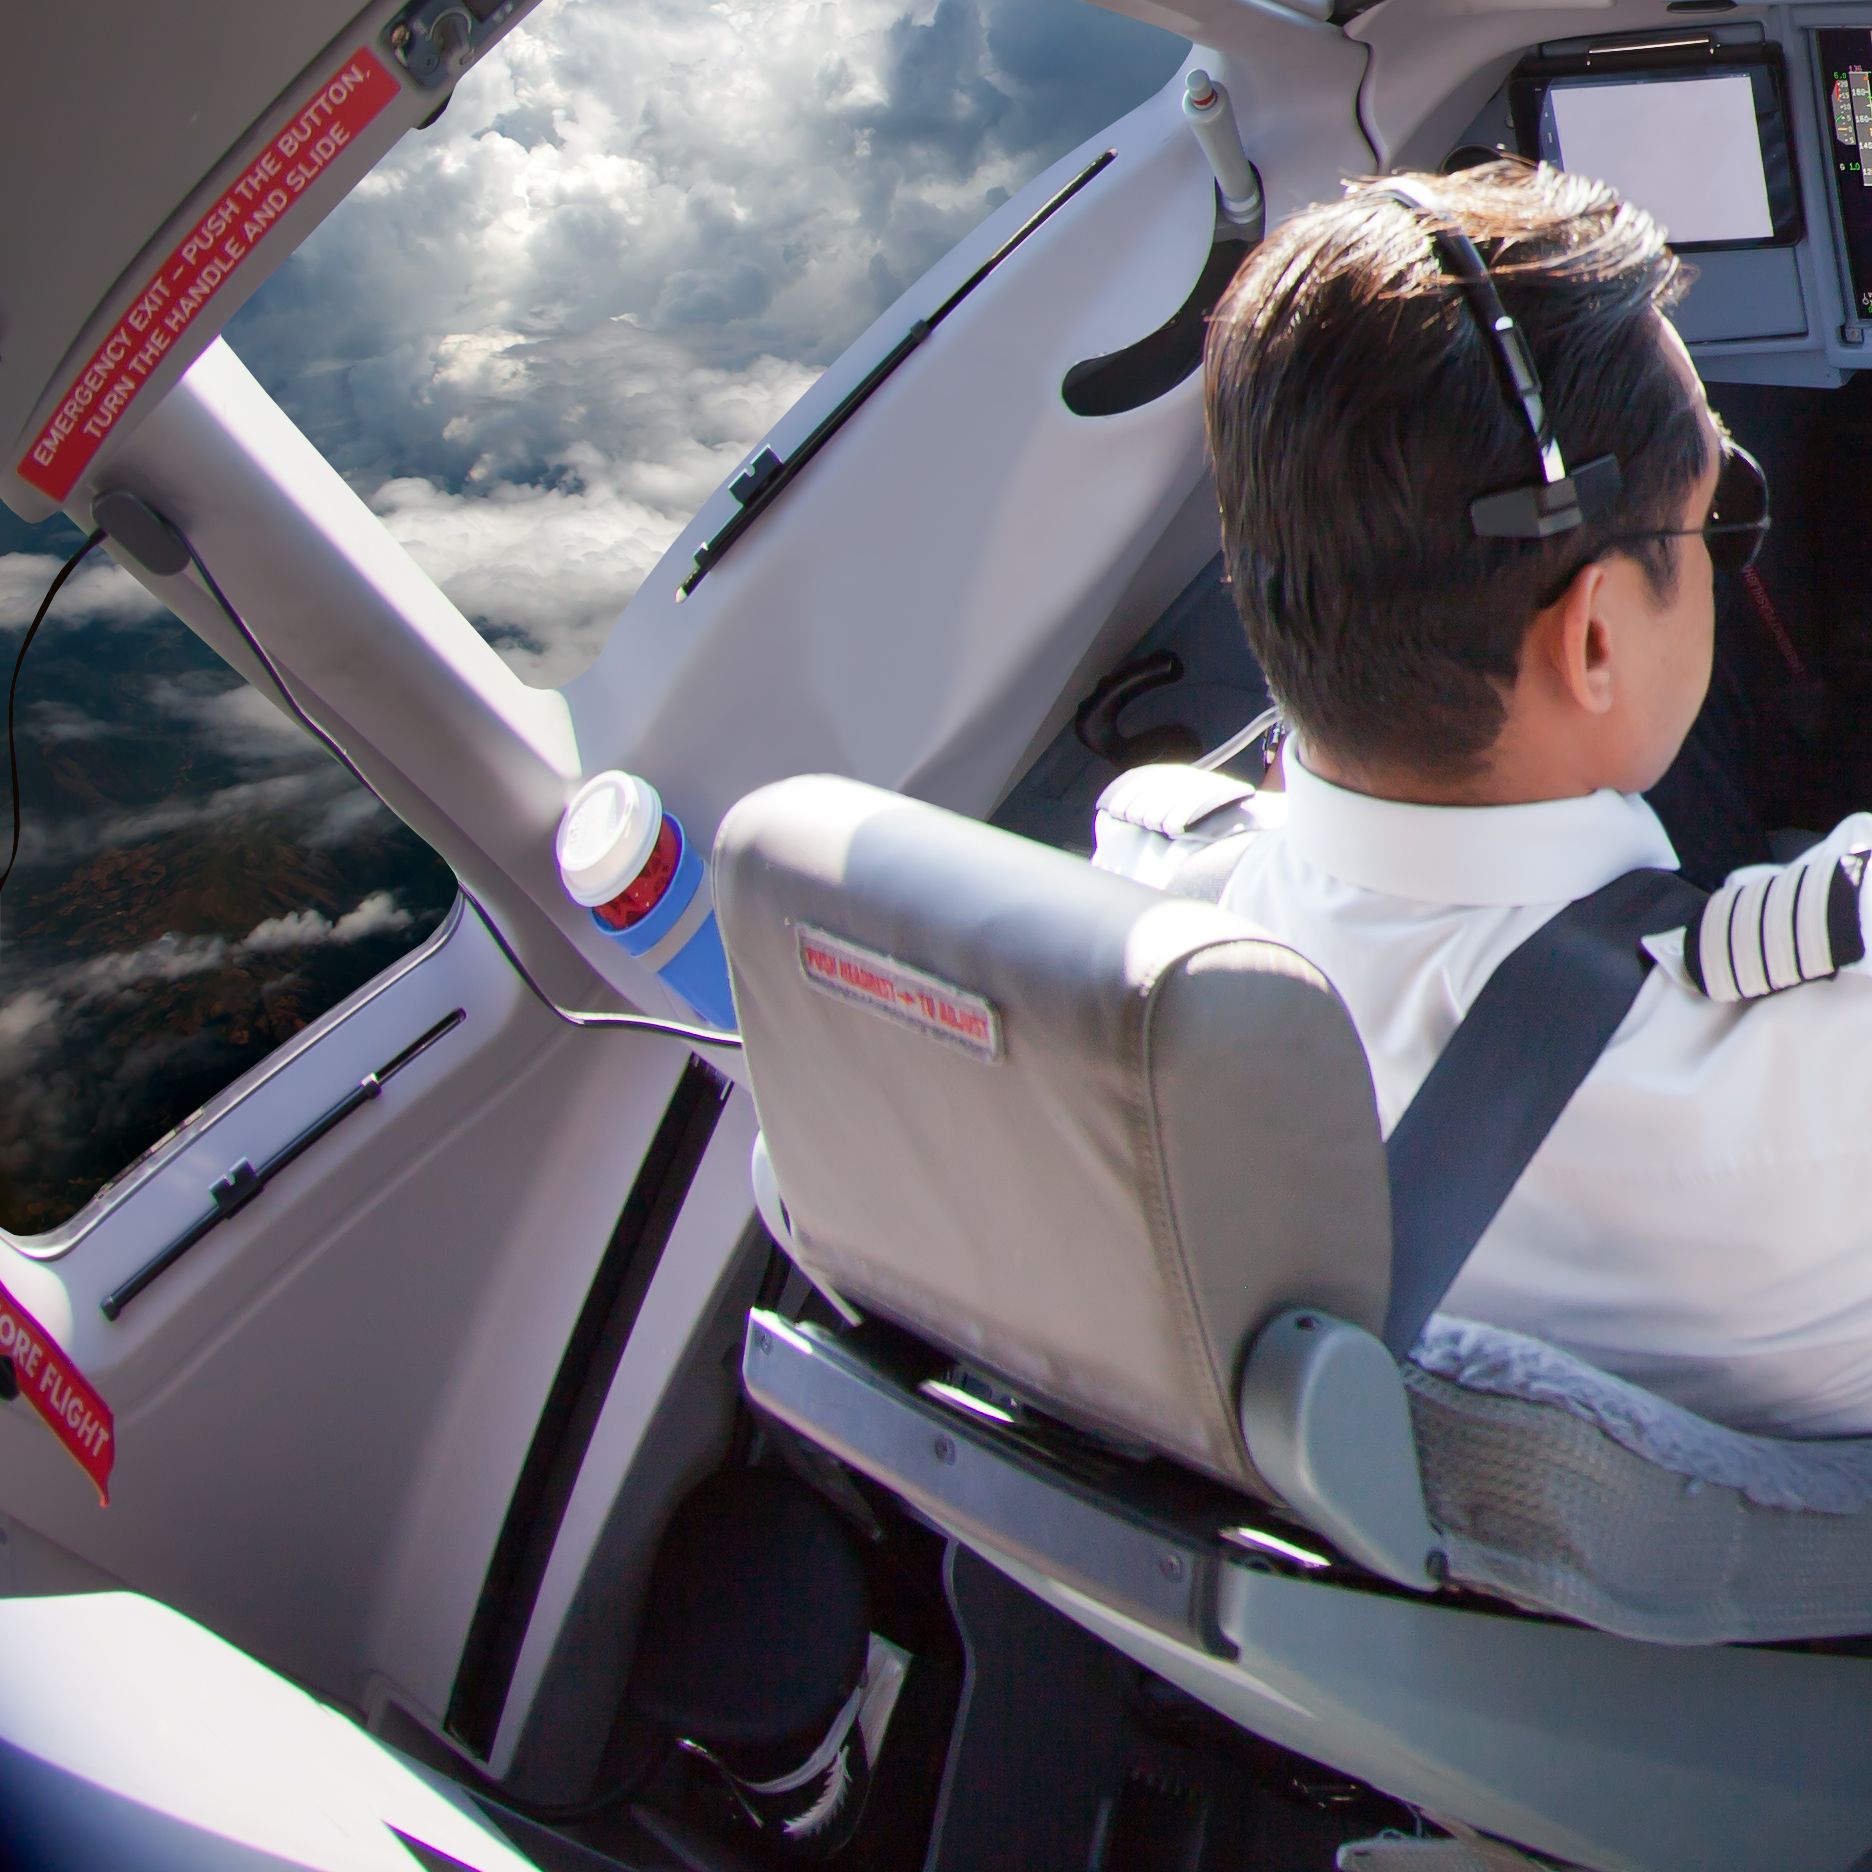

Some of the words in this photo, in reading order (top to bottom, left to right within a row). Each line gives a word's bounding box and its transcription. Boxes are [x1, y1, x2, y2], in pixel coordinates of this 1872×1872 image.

[33, 327, 131, 467] EMERGENCY
[128, 277, 170, 332] EXIT
[182, 198, 240, 266] PUSH
[235, 152, 282, 201] THE
[278, 64, 371, 158] BUTTON,
[84, 375, 136, 438] TURN
[129, 328, 171, 375] THE
[164, 236, 246, 332] HANDLE
[243, 188, 288, 243] AND
[286, 120, 350, 193] SLIDE
[39, 1363, 109, 1457] FLIGHT
